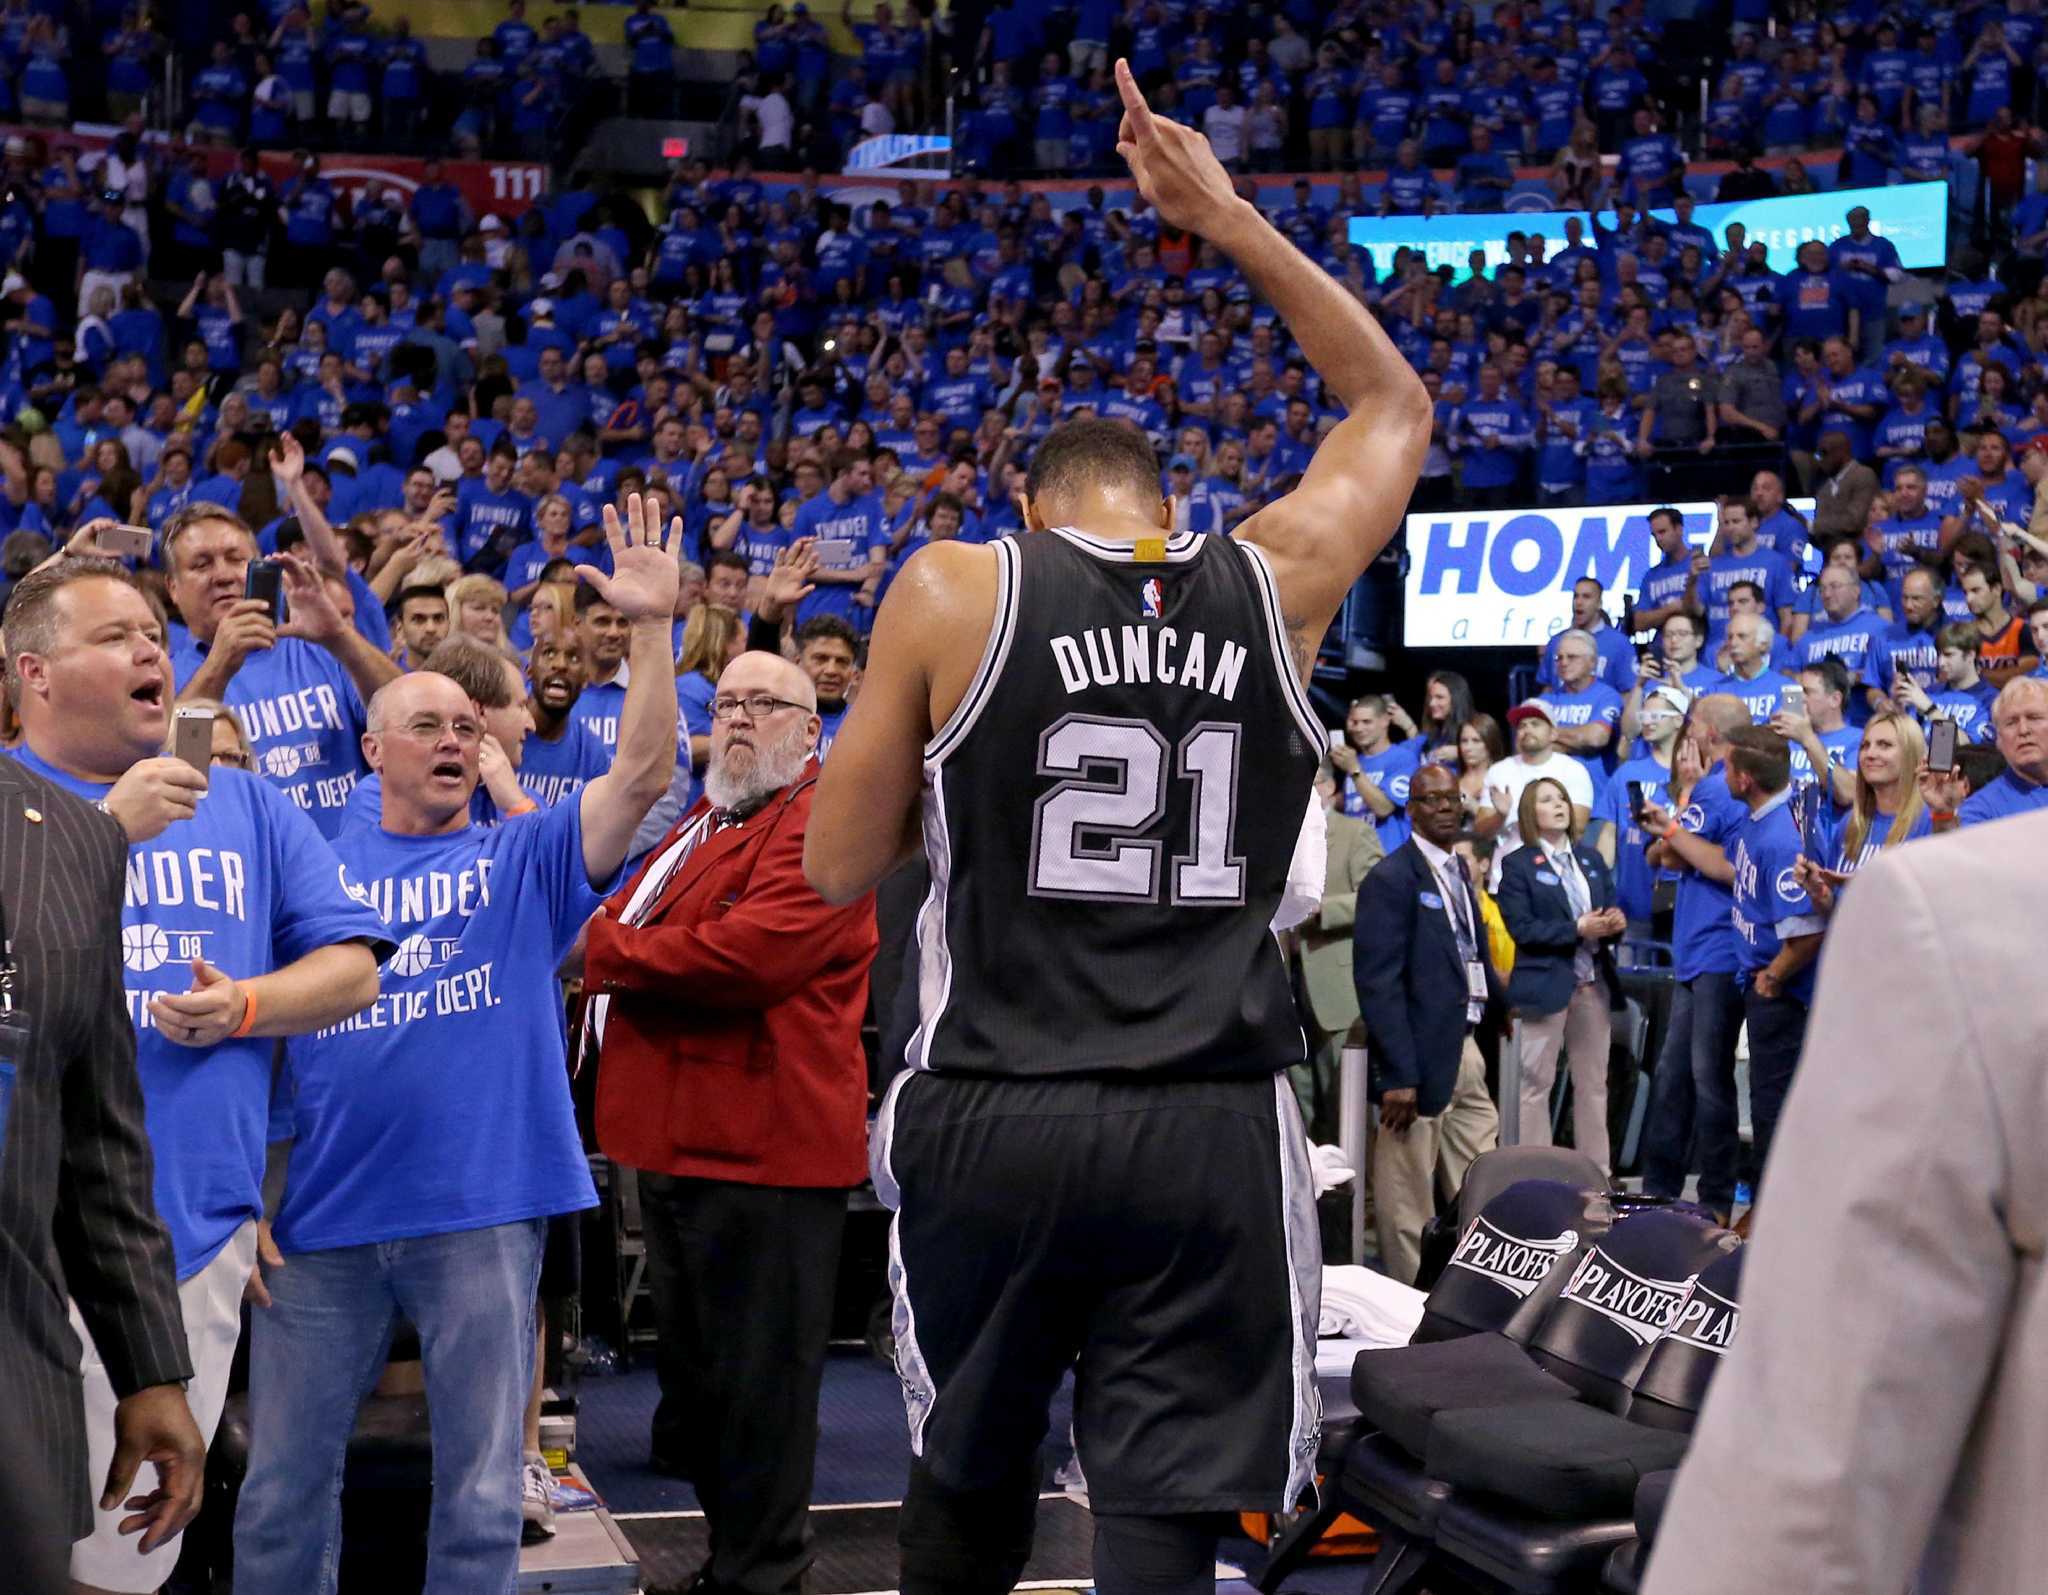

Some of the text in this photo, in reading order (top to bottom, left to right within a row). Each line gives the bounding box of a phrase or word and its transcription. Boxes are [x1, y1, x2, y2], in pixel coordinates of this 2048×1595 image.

[489, 166, 543, 199] 111
[1745, 224, 1842, 249] TEGRIS
[1650, 572, 1690, 600] THUNDE
[1452, 607, 1563, 641] a fre
[1050, 625, 1248, 702] DUNCAN
[1890, 645, 1938, 669] THUND
[228, 683, 345, 743] UNDER
[315, 769, 358, 809] DEPT
[1027, 712, 1248, 907] 21
[125, 847, 246, 923] NDER
[370, 858, 495, 926] UNDER
[178, 935, 203, 959] 08
[316, 961, 502, 1041] LETIC DEPT.
[1460, 1231, 1560, 1281] PLAYOFFS
[1574, 1264, 1683, 1328] PLAYOFFS
[1677, 1299, 1740, 1347] PLAY
